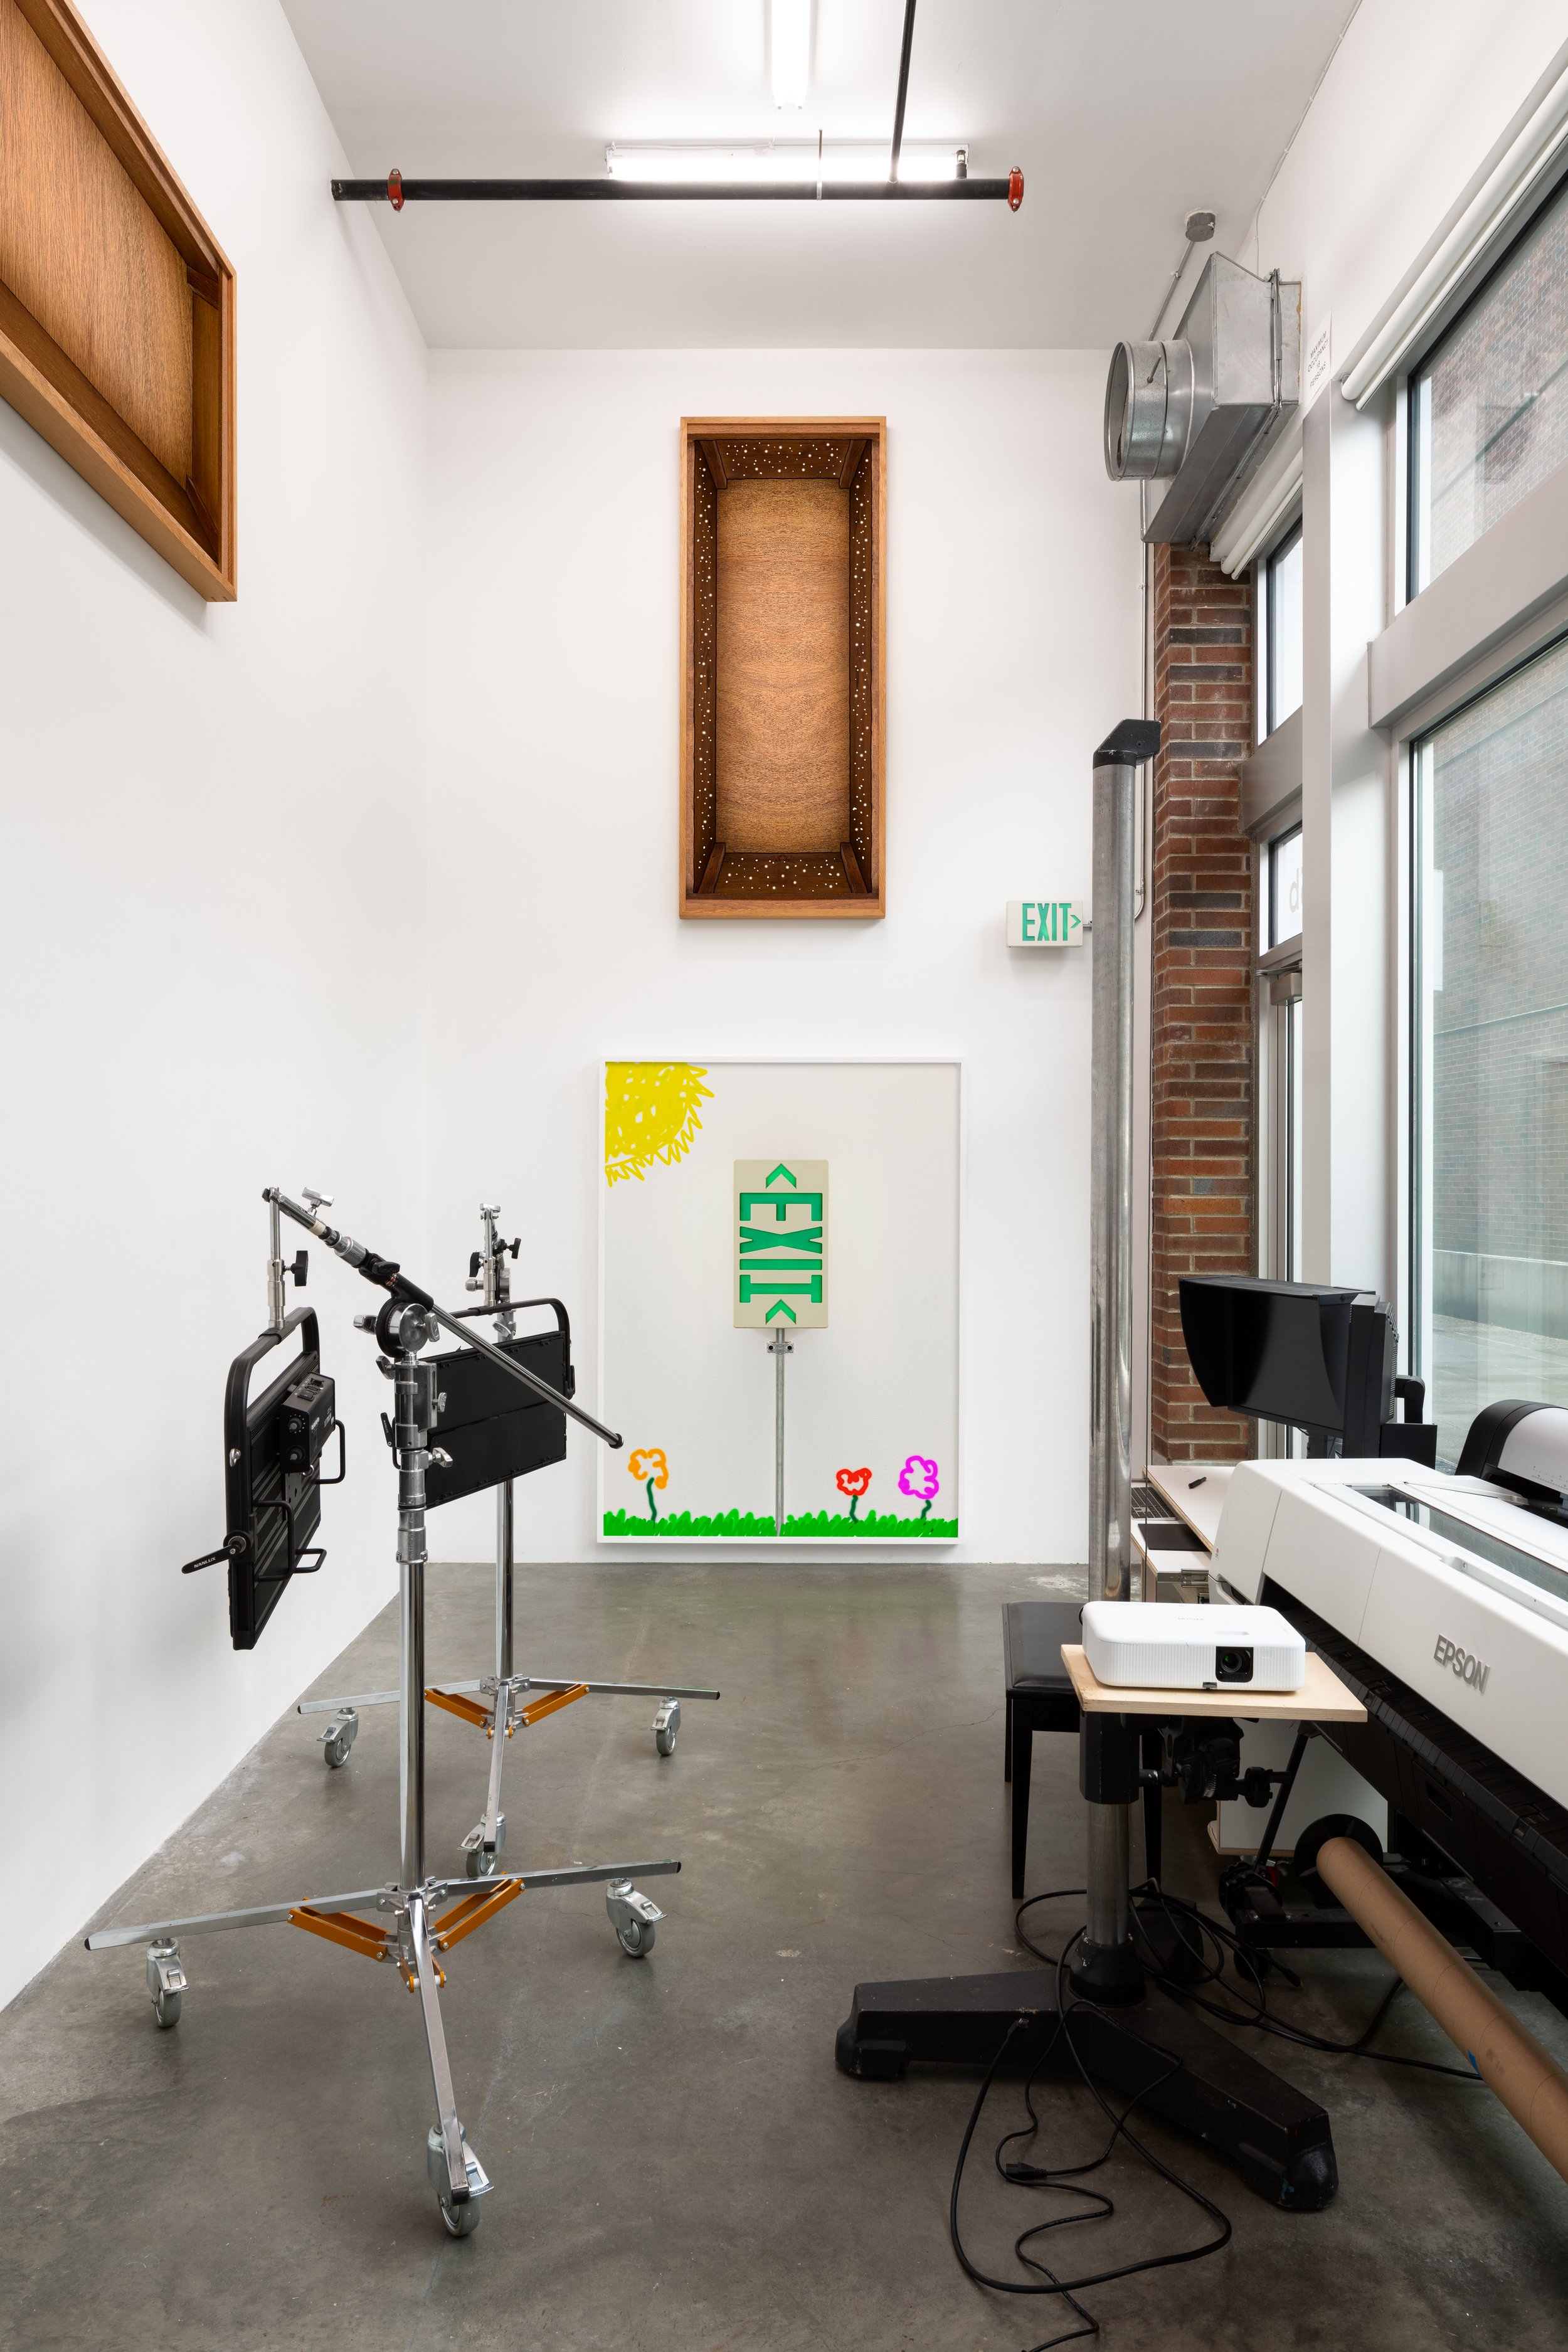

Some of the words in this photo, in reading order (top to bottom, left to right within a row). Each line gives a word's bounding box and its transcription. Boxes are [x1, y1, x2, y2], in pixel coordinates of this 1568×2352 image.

[1307, 338, 1328, 372] OCCUPANCY
[1310, 331, 1327, 359] MAXIMUM
[1310, 361, 1326, 389] PERSONS
[1022, 903, 1072, 941] EXIT
[739, 1192, 823, 1304] EXIT
[194, 1556, 216, 1569] NANLUX
[1433, 1634, 1490, 1694] EPSON
